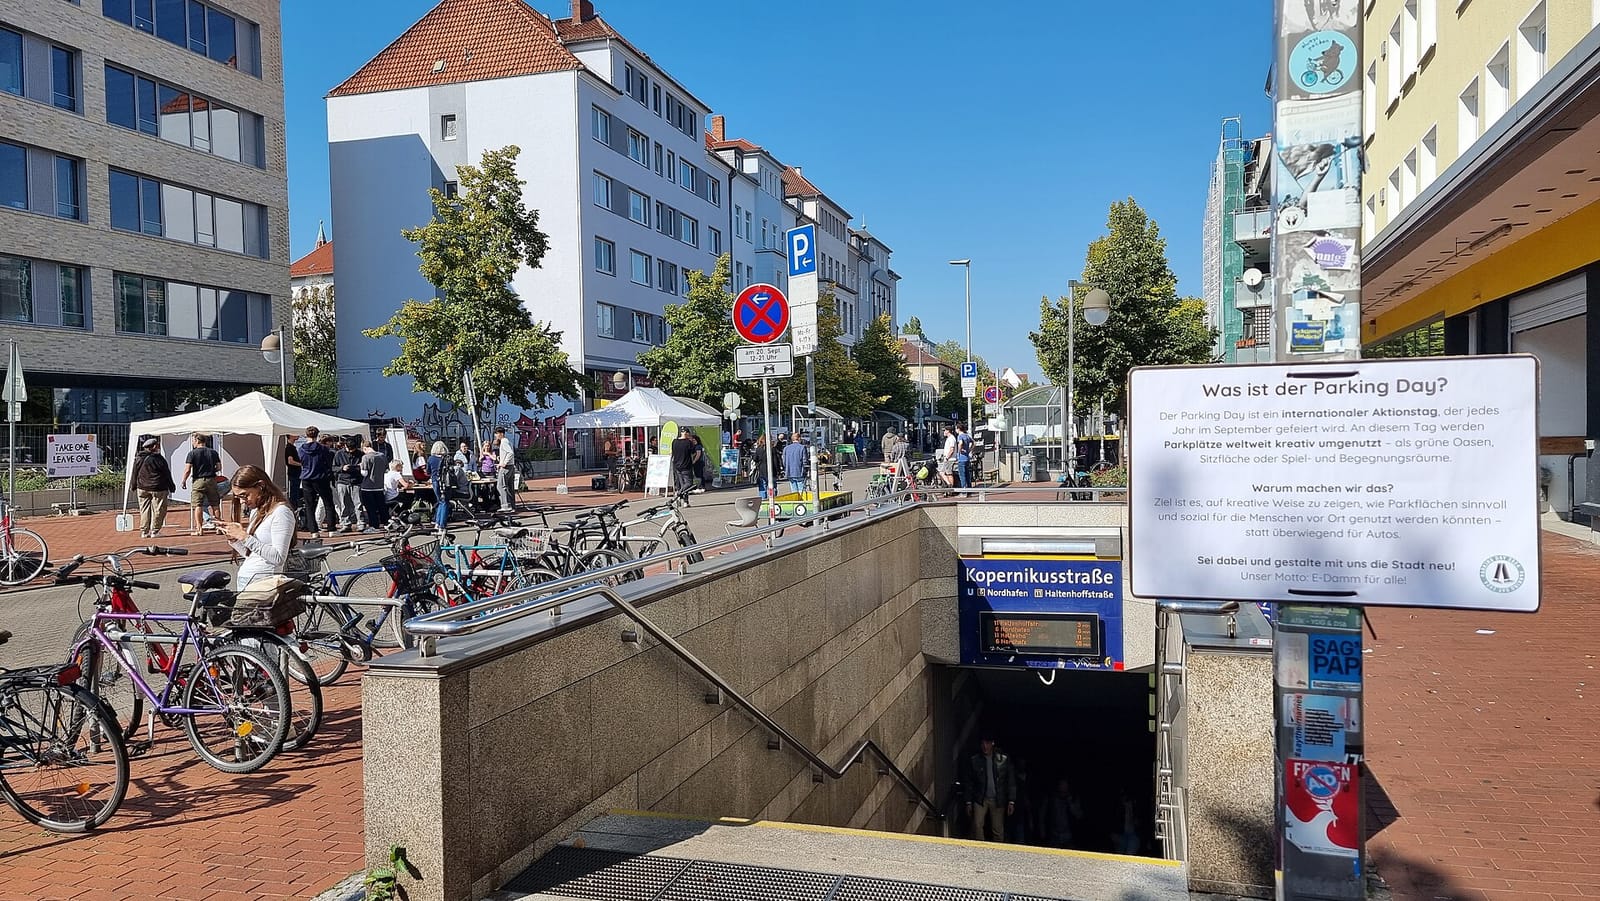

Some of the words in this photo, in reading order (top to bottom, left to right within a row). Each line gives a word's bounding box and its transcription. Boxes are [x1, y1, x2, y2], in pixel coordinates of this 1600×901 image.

[793, 234, 808, 270] P
[964, 365, 972, 376] P
[1202, 384, 1241, 397] Was
[1247, 382, 1268, 396] ist
[1275, 382, 1308, 397] der
[1314, 379, 1389, 397] Parking
[1396, 377, 1448, 396] Day?
[1159, 412, 1177, 420] Der
[1181, 411, 1220, 421] Parking
[1223, 410, 1244, 421] Day
[1248, 411, 1259, 419] ist
[1262, 410, 1278, 419] ein
[1281, 408, 1369, 418] internationaler
[1371, 407, 1440, 418] Aktionstag,
[1443, 406, 1464, 416] der
[1466, 405, 1499, 418] jedes
[1172, 426, 1195, 435] Jahr
[1198, 426, 1211, 434] im
[1214, 424, 1272, 436] September
[1275, 423, 1318, 436] gefeiert
[1321, 423, 1347, 432] wird.
[1350, 423, 1365, 432] An
[1368, 423, 1410, 432] diesem
[1413, 422, 1436, 434] Tag
[1440, 421, 1484, 432] werden
[75, 443, 89, 451] ONE
[1164, 440, 1222, 451] Parkplätze
[1225, 439, 1271, 448] weltweit
[1275, 439, 1315, 448] kreativ
[1318, 439, 1381, 450] umgenutzt
[1395, 438, 1411, 447] als
[1414, 438, 1449, 449] grüne
[1453, 437, 1493, 447] Oasen,
[53, 455, 74, 463] LEAVE
[1199, 454, 1250, 464] Sitzfläche
[1253, 454, 1278, 463] oder
[1281, 453, 1311, 464] Spiel-
[1314, 453, 1336, 463] und
[1339, 453, 1452, 464] Begegnungsräume.
[1251, 484, 1292, 492] Warum
[1296, 483, 1341, 493] machen
[1344, 483, 1362, 492] wir
[1365, 483, 1393, 493] das?
[1154, 497, 1172, 508] Ziel
[1175, 498, 1186, 506] ist
[1189, 498, 1203, 508] es,
[1205, 497, 1223, 507] auf
[1226, 498, 1269, 507] kreative
[1271, 498, 1304, 509] Weise
[1307, 500, 1320, 508] zu
[1323, 499, 1363, 510] zeigen,
[1365, 500, 1384, 508] wie
[1388, 498, 1458, 509] Parkflächen
[1461, 499, 1506, 509] sinnvoll
[1158, 511, 1177, 521] und
[1180, 512, 1209, 521] sozial
[1212, 512, 1227, 521] für
[1230, 512, 1246, 522] die
[1249, 512, 1303, 524] Menschen
[1306, 515, 1324, 523] vor
[1327, 513, 1345, 523] Ort
[1348, 515, 1391, 525] genutzt
[1394, 514, 1438, 524] werden
[1442, 514, 1491, 525] könnten
[1245, 528, 1268, 536] statt
[1272, 528, 1343, 539] überwiegend
[1347, 528, 1363, 538] für
[1365, 529, 1400, 539] Autos.
[1197, 555, 1213, 565] Sei
[1216, 556, 1247, 565] dabei
[1250, 557, 1271, 566] und
[1274, 558, 1321, 568] gestalte
[1324, 558, 1343, 568] mit
[1370, 559, 1388, 569] die
[1391, 560, 1424, 570] Stadt
[1428, 562, 1455, 570] neu!
[966, 568, 1114, 586] Kopernikusstraße
[1240, 571, 1272, 582] Unser
[1274, 571, 1309, 583] Motto:
[1311, 573, 1361, 583] E-Damm
[1364, 574, 1380, 584] für
[1383, 575, 1406, 584] alle!
[968, 588, 974, 596] U
[988, 589, 1028, 597] Nordhafen
[1045, 590, 1114, 598] Haltenhoffstraße
[1314, 656, 1362, 675] PAP
